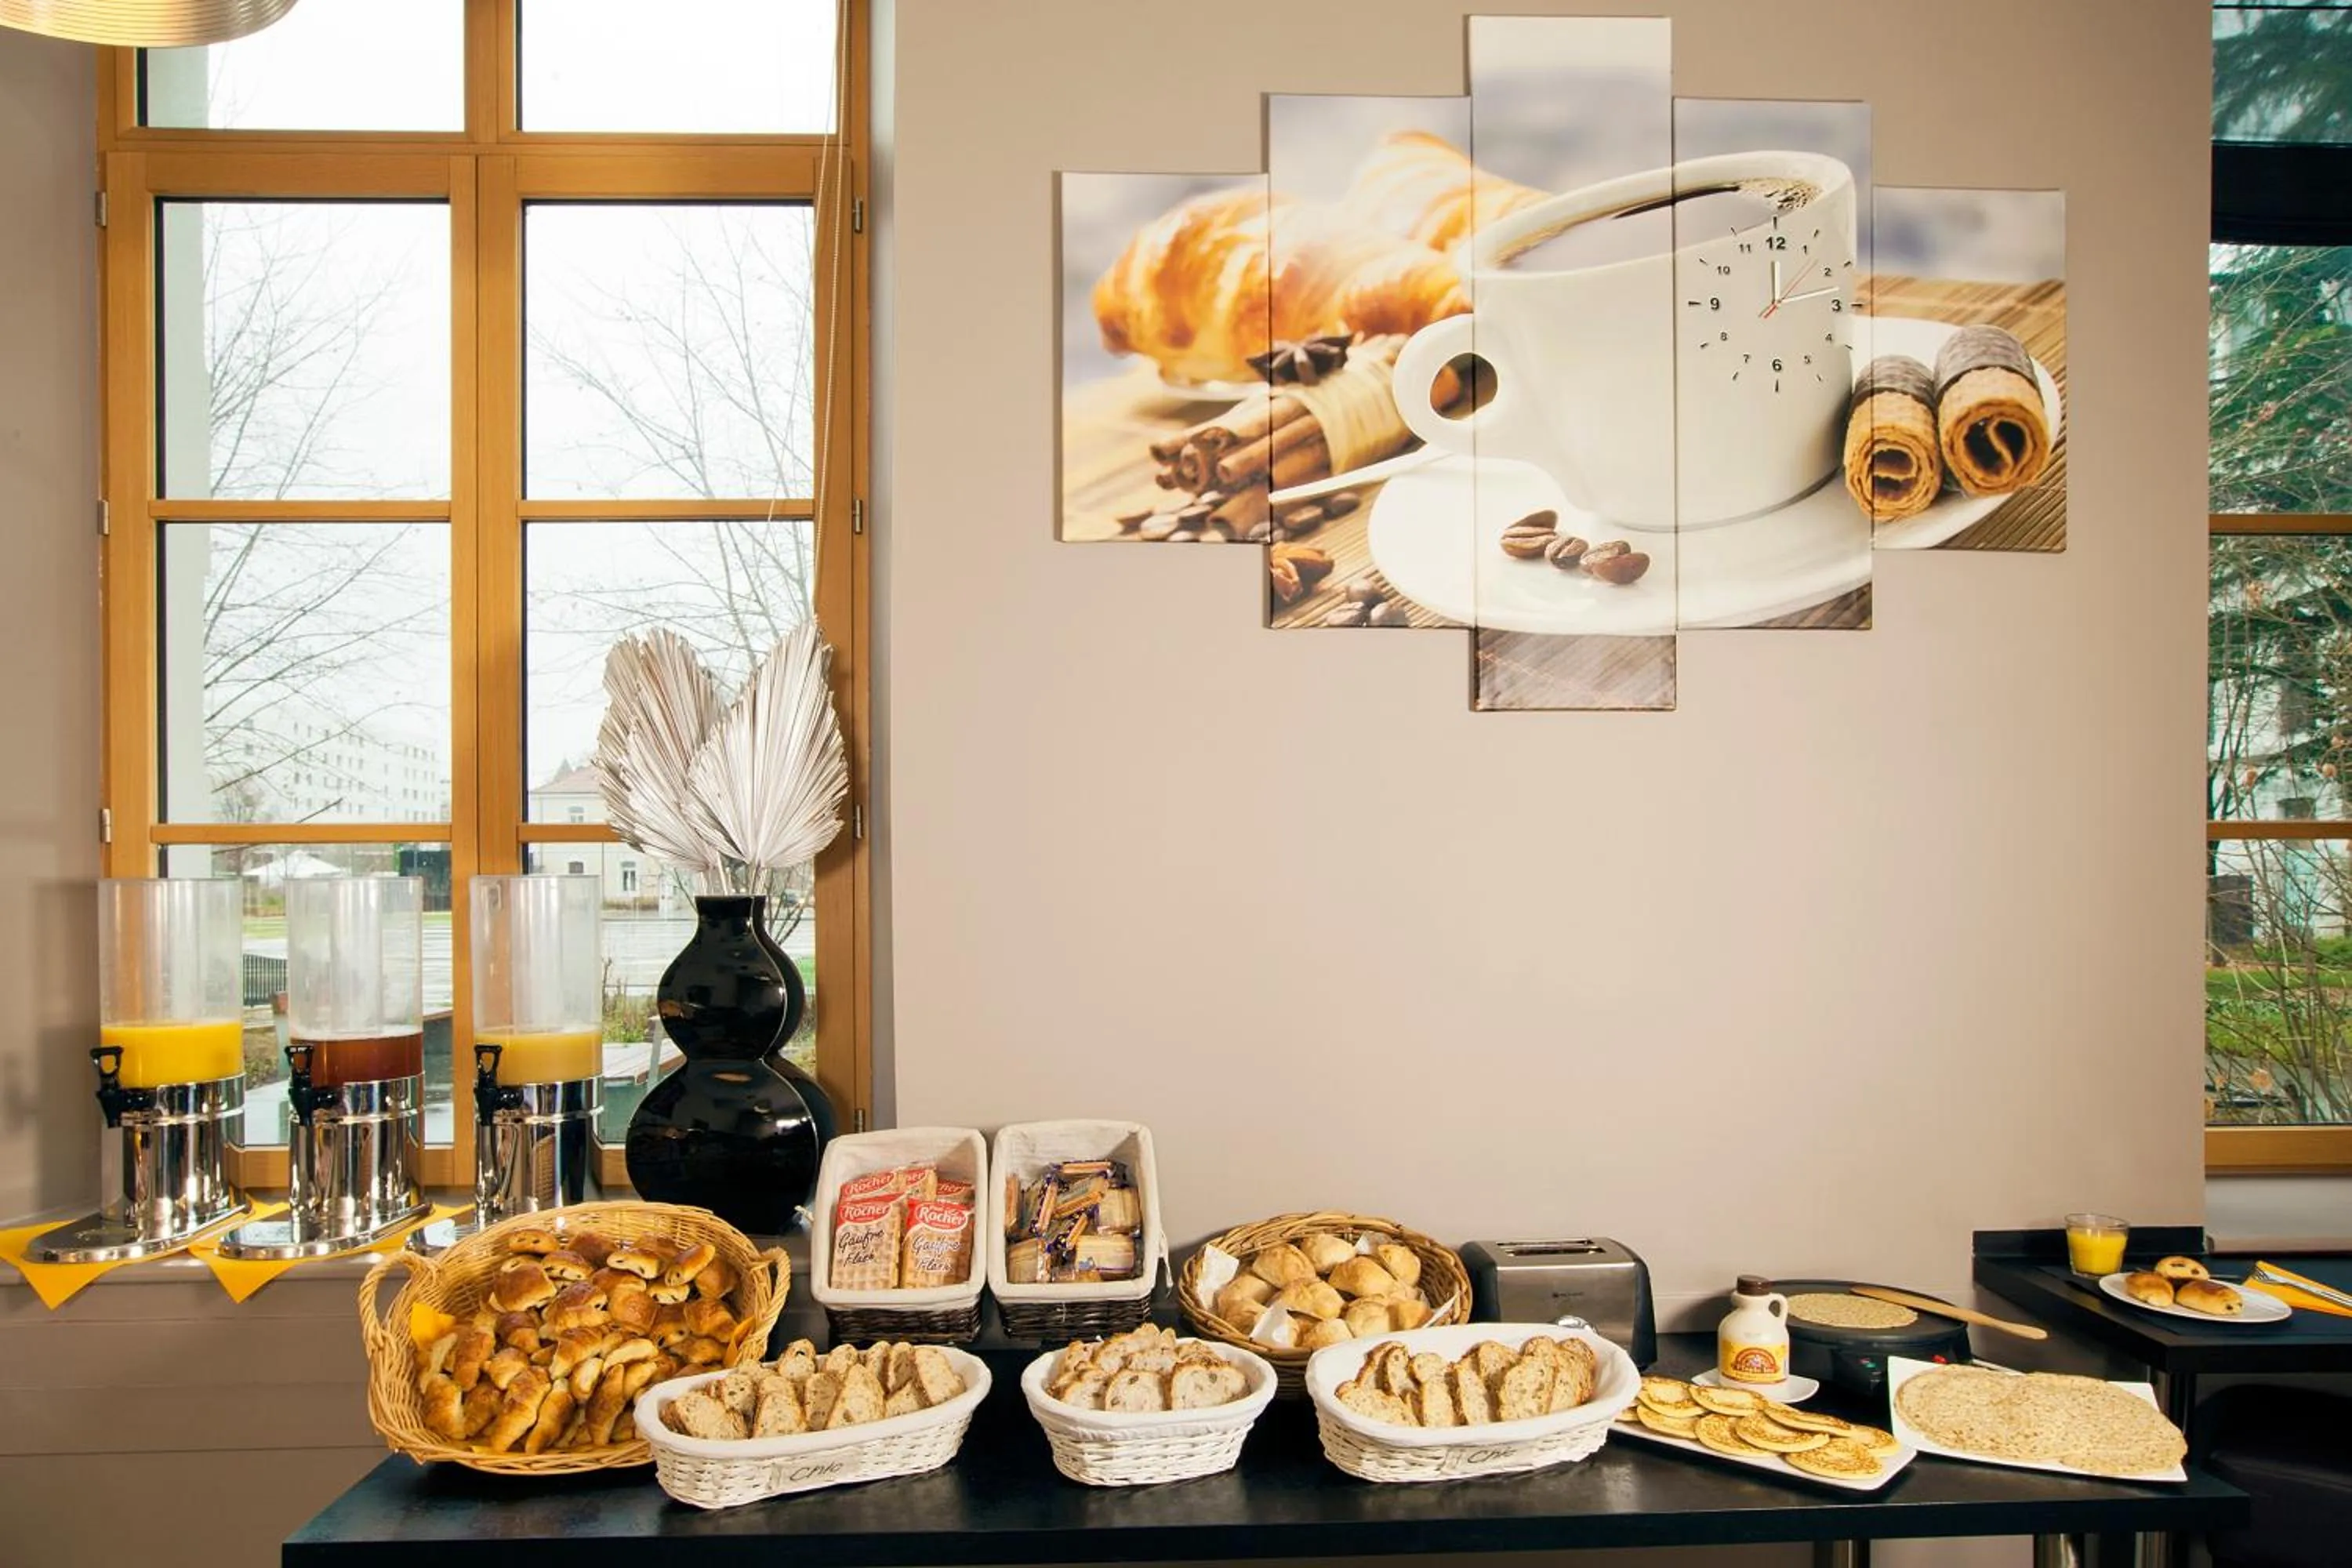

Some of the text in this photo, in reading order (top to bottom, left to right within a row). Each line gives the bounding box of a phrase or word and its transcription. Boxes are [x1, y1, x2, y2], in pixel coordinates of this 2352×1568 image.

[1738, 244, 1752, 252] 11
[1765, 236, 1786, 250] 12
[1802, 245, 1808, 254] 1
[1716, 266, 1730, 275] 10
[1824, 267, 1831, 277] 2
[1710, 297, 1720, 310] 9
[1831, 299, 1842, 312] 3
[1719, 332, 1728, 341] 8
[1824, 332, 1834, 343] 4
[1743, 354, 1751, 364] 7
[1803, 355, 1811, 365] 5
[1771, 358, 1782, 372] 6
[918, 1207, 967, 1225] Rocher
[838, 1229, 884, 1253] Gaufre
